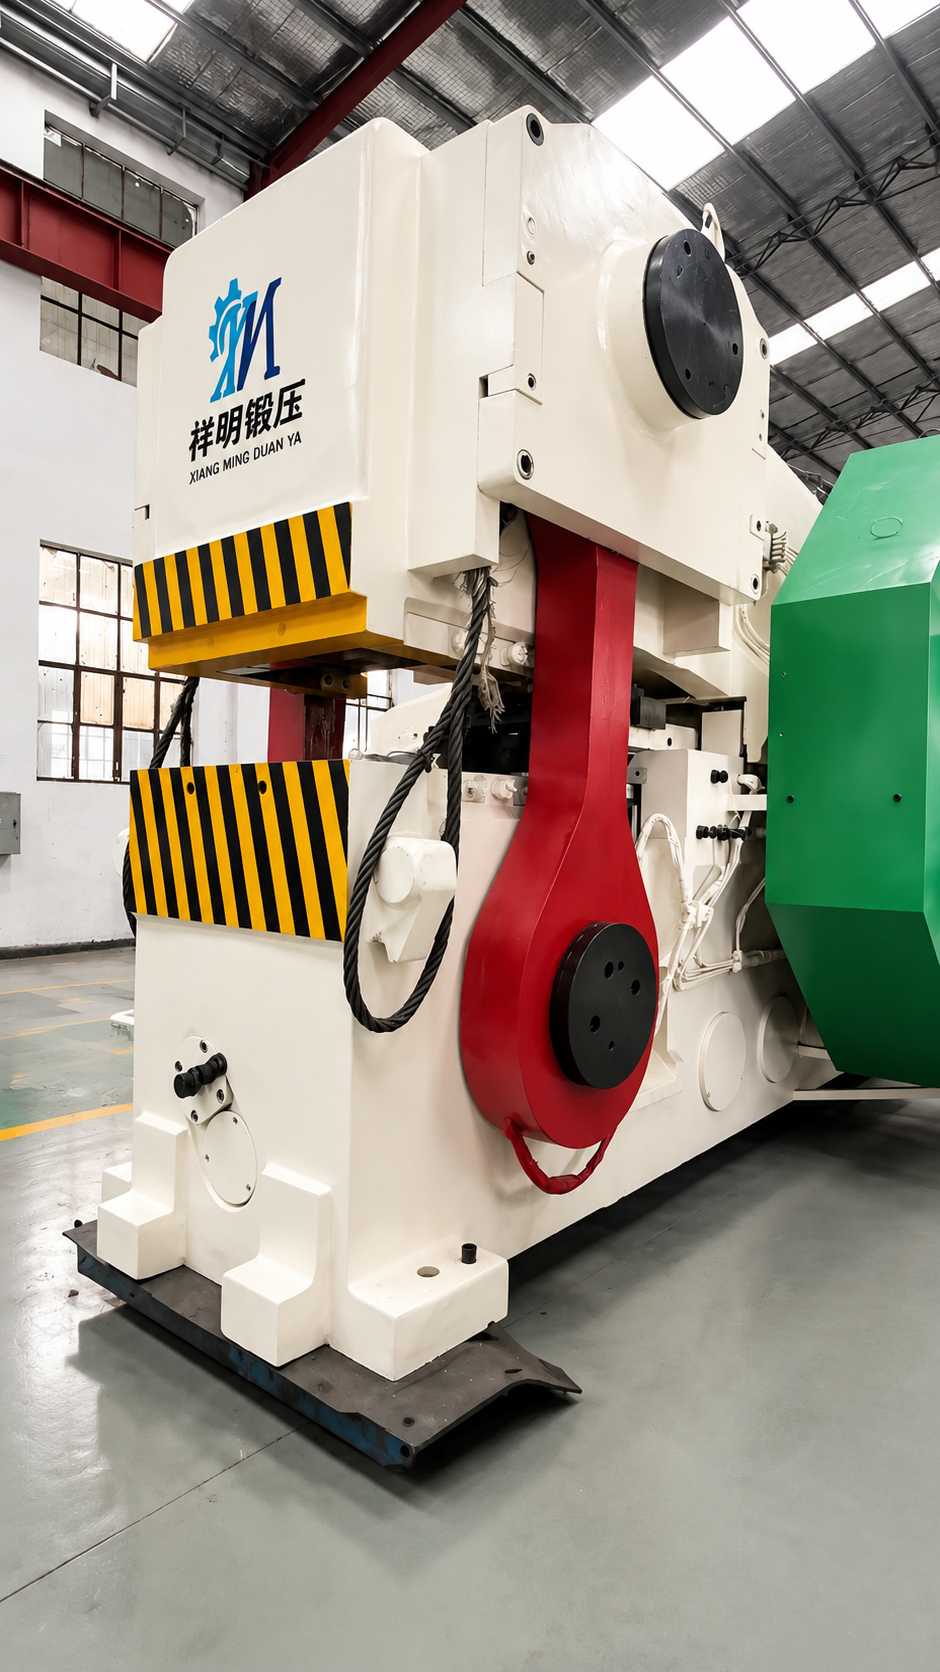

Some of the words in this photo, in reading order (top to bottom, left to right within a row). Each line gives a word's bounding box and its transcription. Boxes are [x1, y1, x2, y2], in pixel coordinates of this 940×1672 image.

[189, 378, 305, 462] 祥明锻压
[189, 462, 220, 485] XIANG
[222, 450, 250, 472] MING
[253, 437, 284, 461] DUAN
[287, 431, 302, 446] YA
